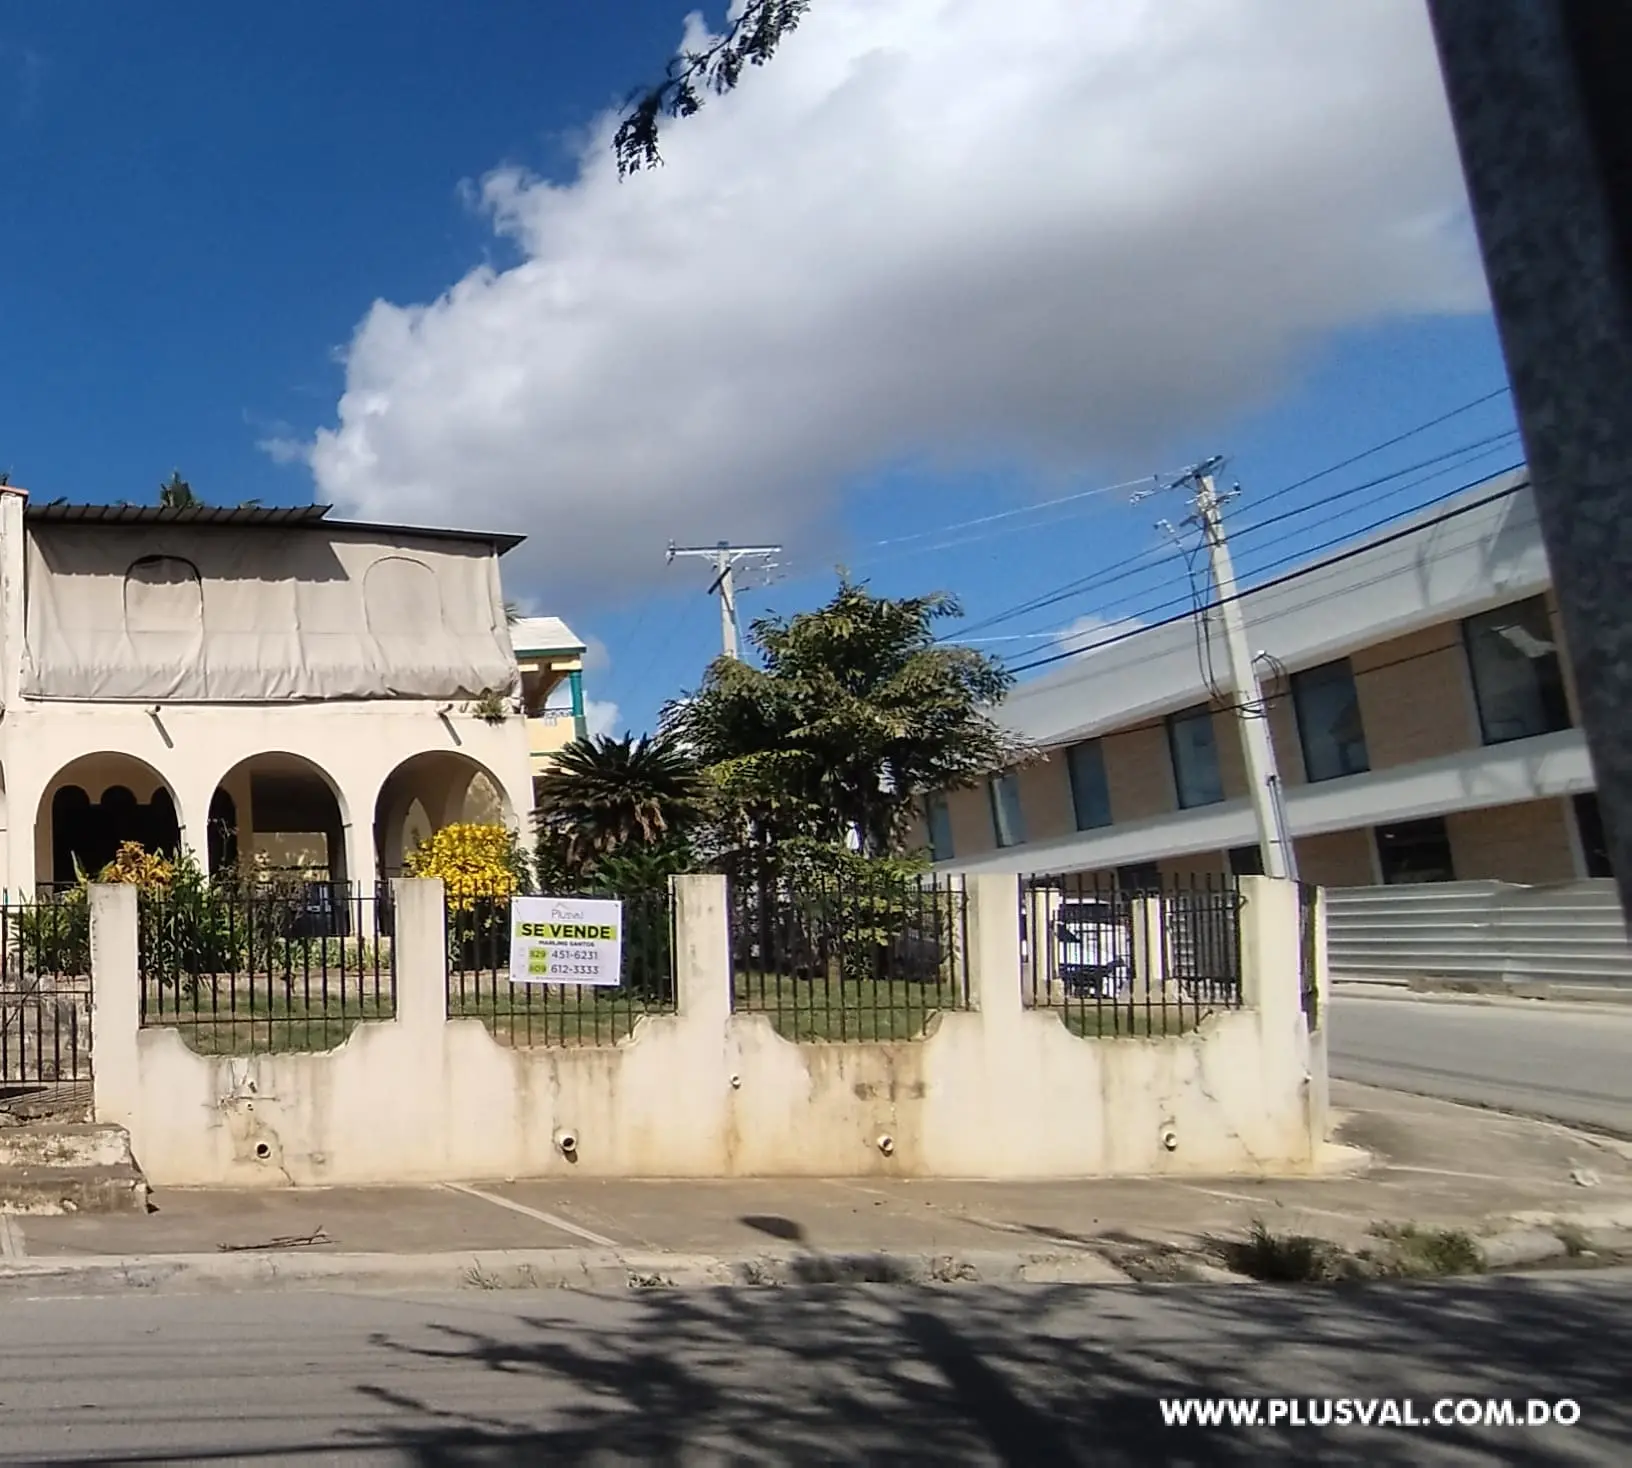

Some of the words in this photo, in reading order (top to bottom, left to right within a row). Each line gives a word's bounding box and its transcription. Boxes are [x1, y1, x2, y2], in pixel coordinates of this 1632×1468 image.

[522, 923, 545, 936] SE
[550, 925, 610, 938] VENDE
[552, 950, 598, 960] 451-6231
[551, 965, 599, 974] 612-3333
